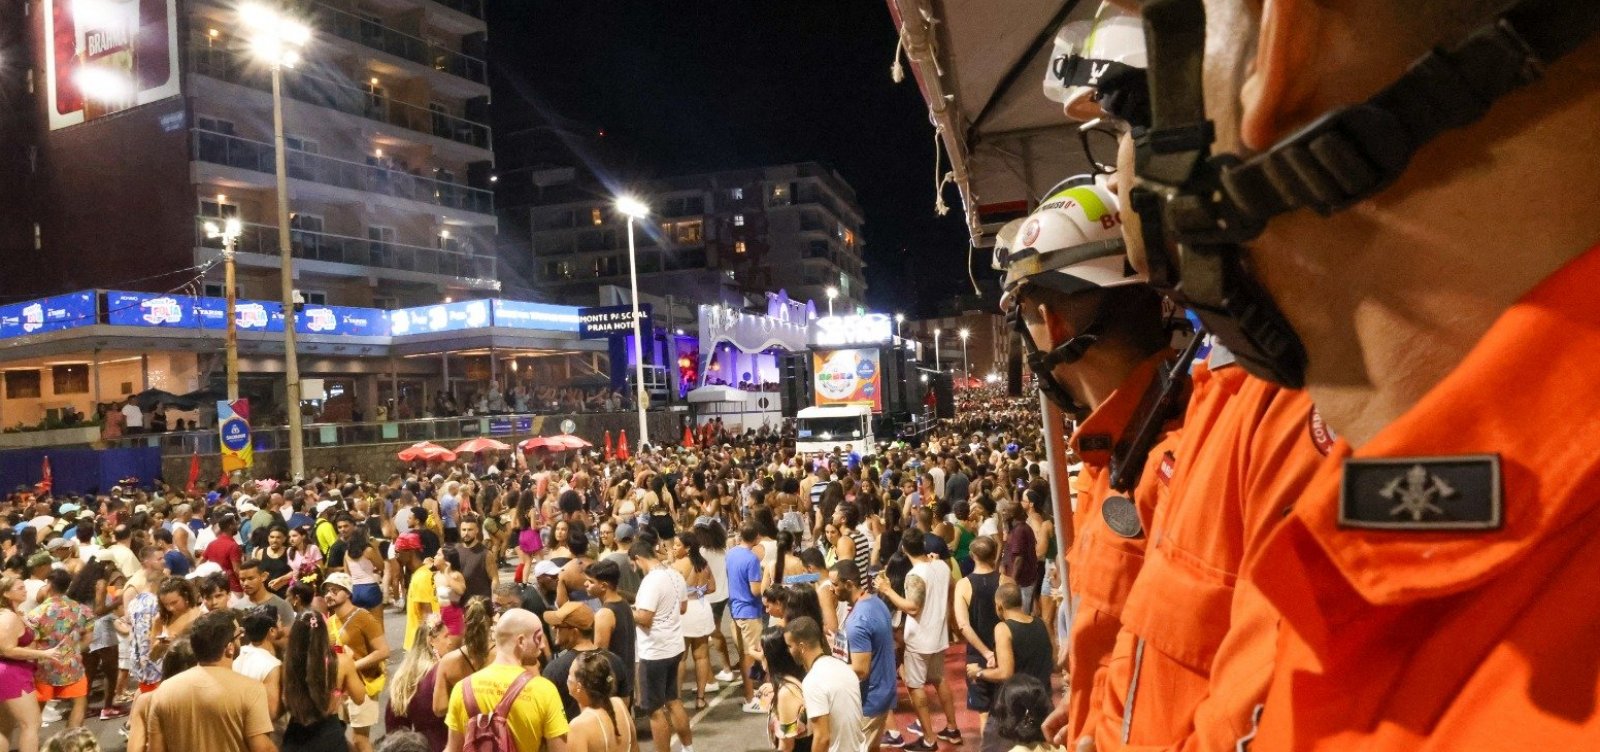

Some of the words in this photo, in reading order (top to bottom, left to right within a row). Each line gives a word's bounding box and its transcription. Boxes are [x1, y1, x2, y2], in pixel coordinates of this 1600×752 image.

[579, 314, 608, 323] MONTE
[587, 323, 612, 331] PRAIA
[614, 321, 637, 330] HOTE
